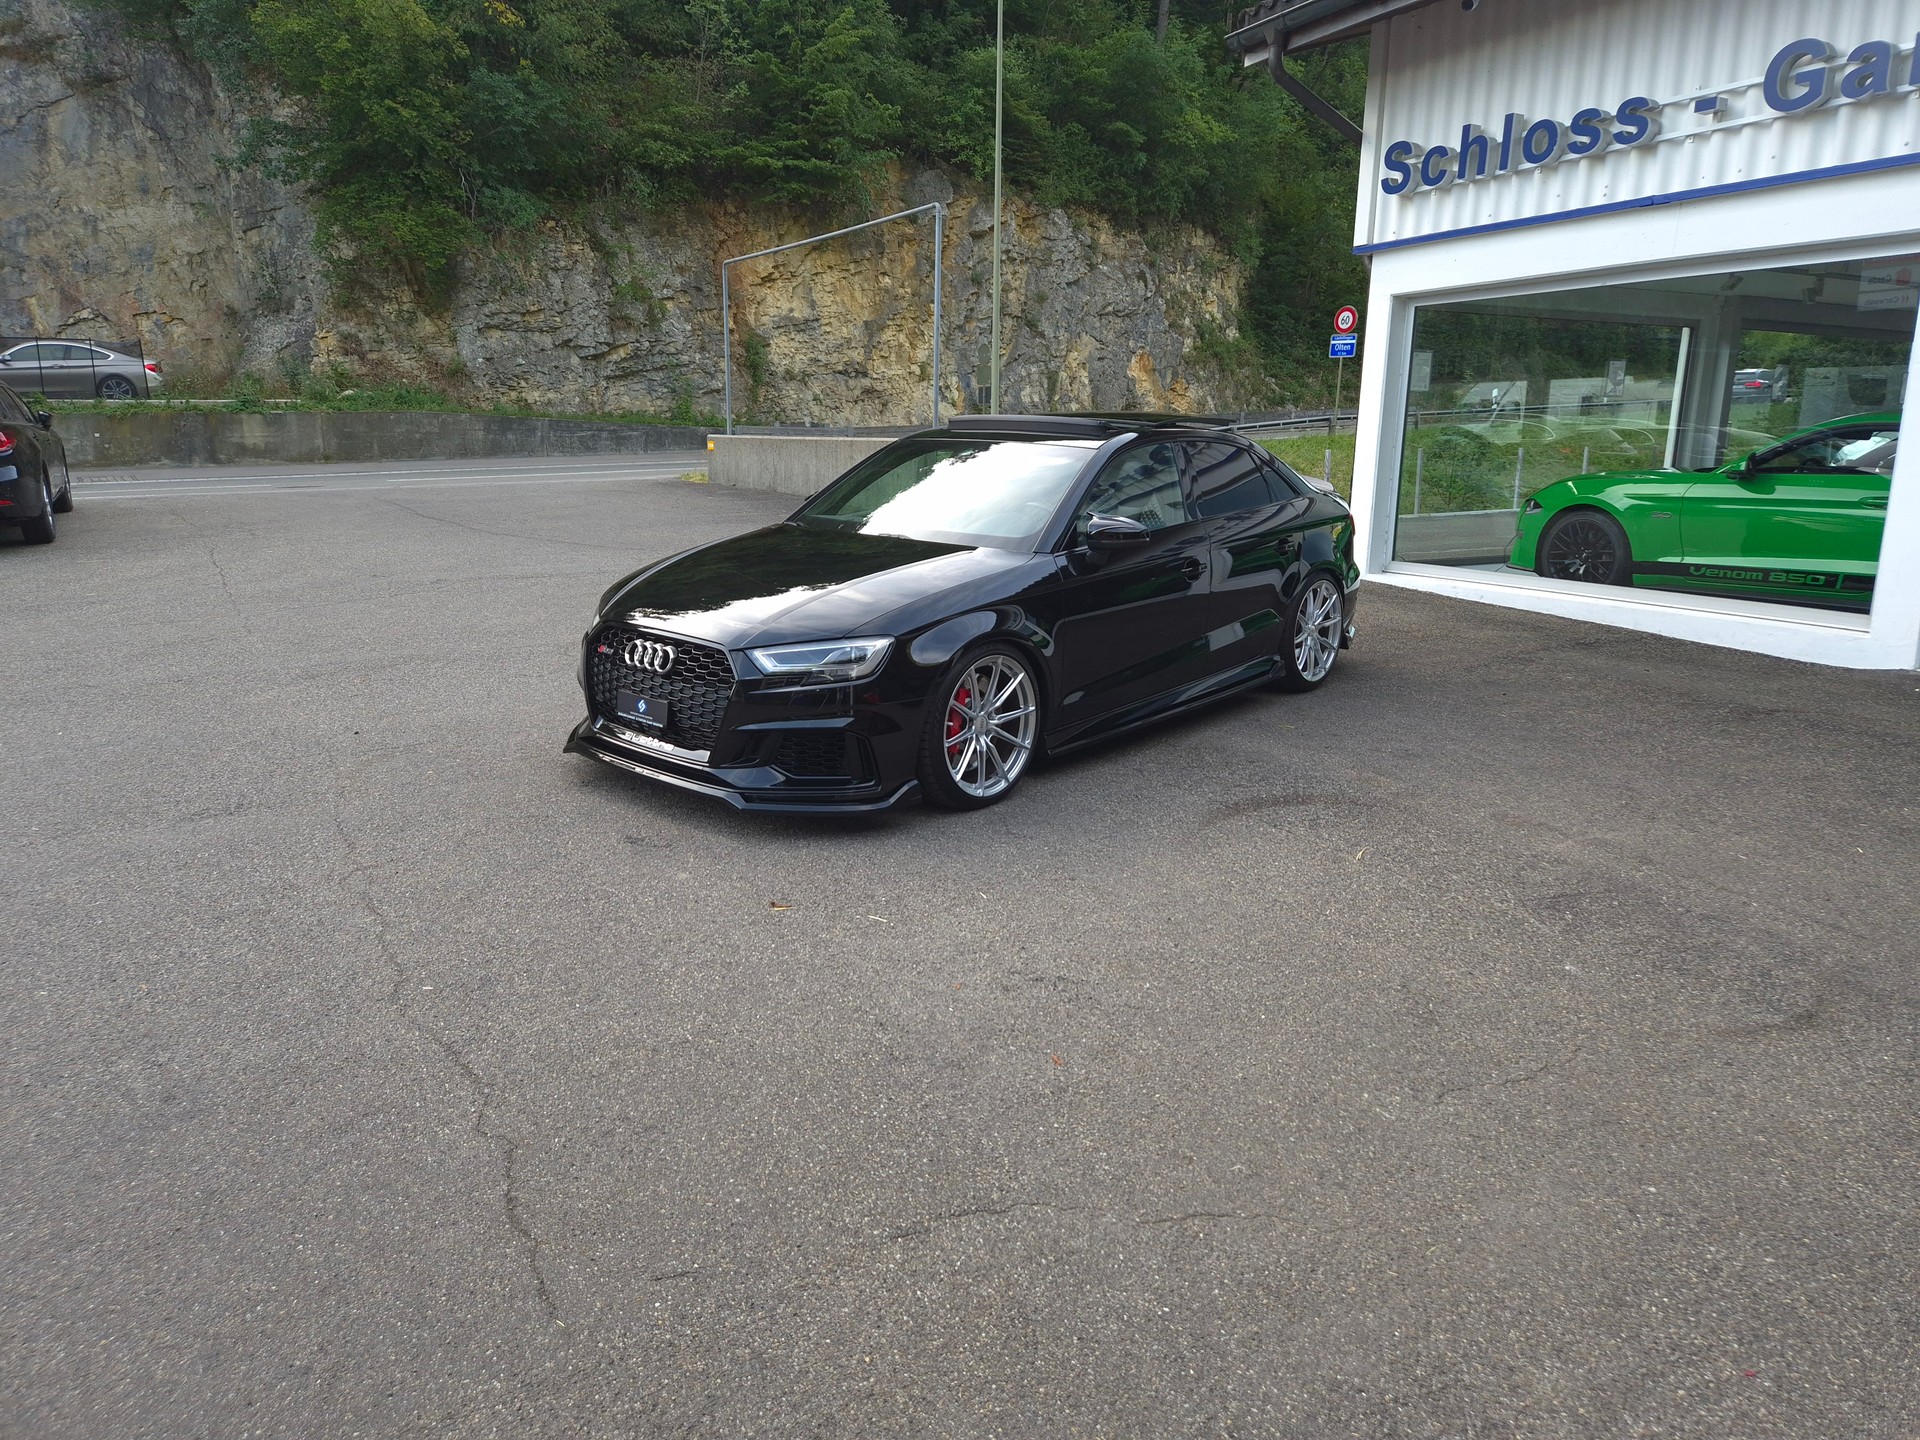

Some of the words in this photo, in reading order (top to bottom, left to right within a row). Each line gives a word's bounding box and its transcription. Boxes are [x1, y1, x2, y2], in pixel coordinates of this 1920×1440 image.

[1380, 96, 1659, 197] Schloss
[1340, 315, 1350, 325] 60
[1335, 343, 1351, 351] Olten
[1689, 565, 1762, 580] Venom
[1768, 571, 1826, 585] 850
